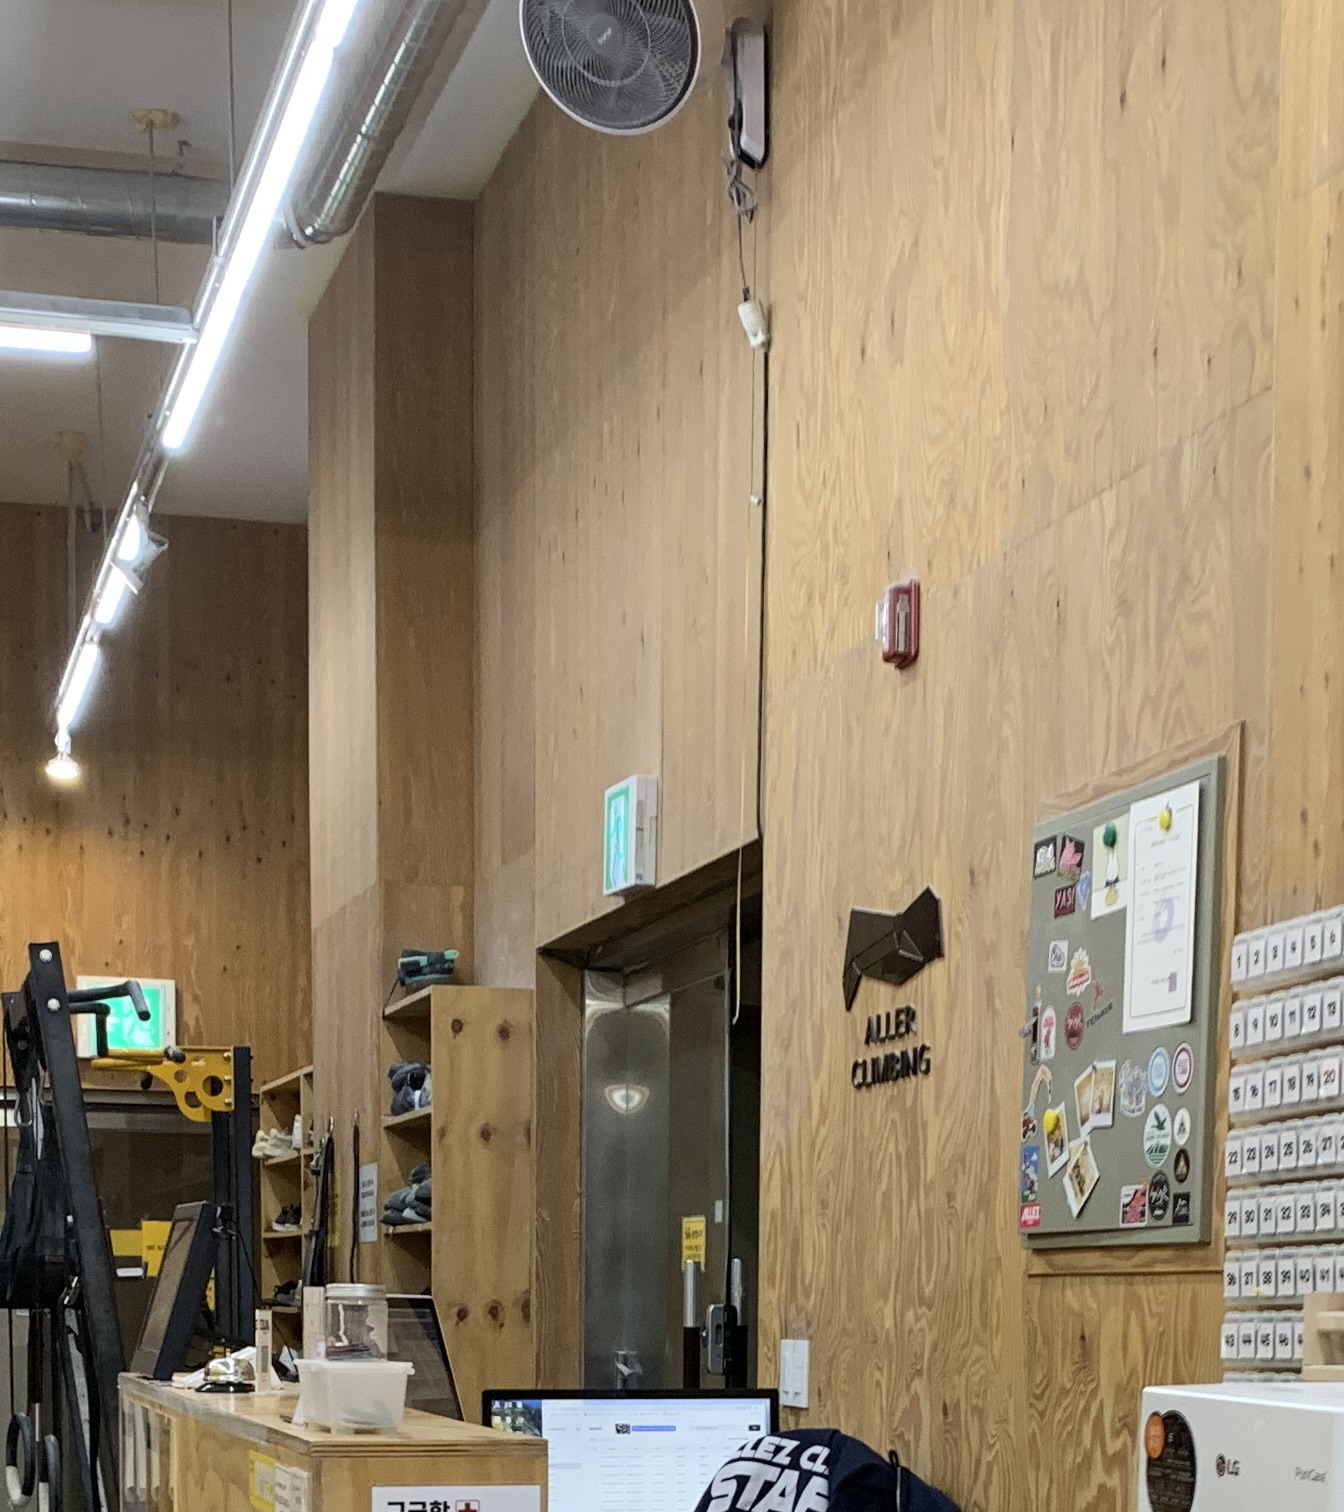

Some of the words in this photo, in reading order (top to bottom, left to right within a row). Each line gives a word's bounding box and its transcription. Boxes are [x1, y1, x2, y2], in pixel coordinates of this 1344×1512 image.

[1237, 954, 1241, 968] 1
[1254, 950, 1259, 965] 2
[1273, 944, 1278, 959] 3
[1291, 941, 1296, 954] 4
[1311, 935, 1316, 950] 5
[1330, 930, 1336, 945] 6
[1234, 1023, 1240, 1038] 8
[1253, 1018, 1258, 1032] 9
[1269, 1013, 1279, 1029] 10
[1288, 1010, 1296, 1024] 11
[1307, 1005, 1317, 1020] 12
[1327, 1000, 1336, 1016] 13
[852, 1043, 931, 1090] CLIMBING
[1233, 1087, 1240, 1101] 15
[1250, 1085, 1259, 1097] 16
[1268, 1080, 1277, 1095] 17
[1287, 1076, 1296, 1091] 18
[1306, 1073, 1315, 1088] 19
[1323, 1069, 1336, 1086] 20
[1228, 1150, 1238, 1165] 22
[1246, 1147, 1256, 1161] 23
[1264, 1144, 1275, 1159] 24
[1283, 1141, 1294, 1157] 25
[1302, 1139, 1313, 1154] 26
[1322, 1136, 1333, 1151] 27
[1227, 1211, 1237, 1225] 29
[1244, 1209, 1255, 1224] 30
[1263, 1207, 1272, 1222] 31
[1281, 1206, 1291, 1221] 32
[1300, 1204, 1311, 1219] 33
[1320, 1203, 1331, 1218] 34
[738, 1435, 801, 1465] LEZ
[799, 1444, 831, 1476] CL
